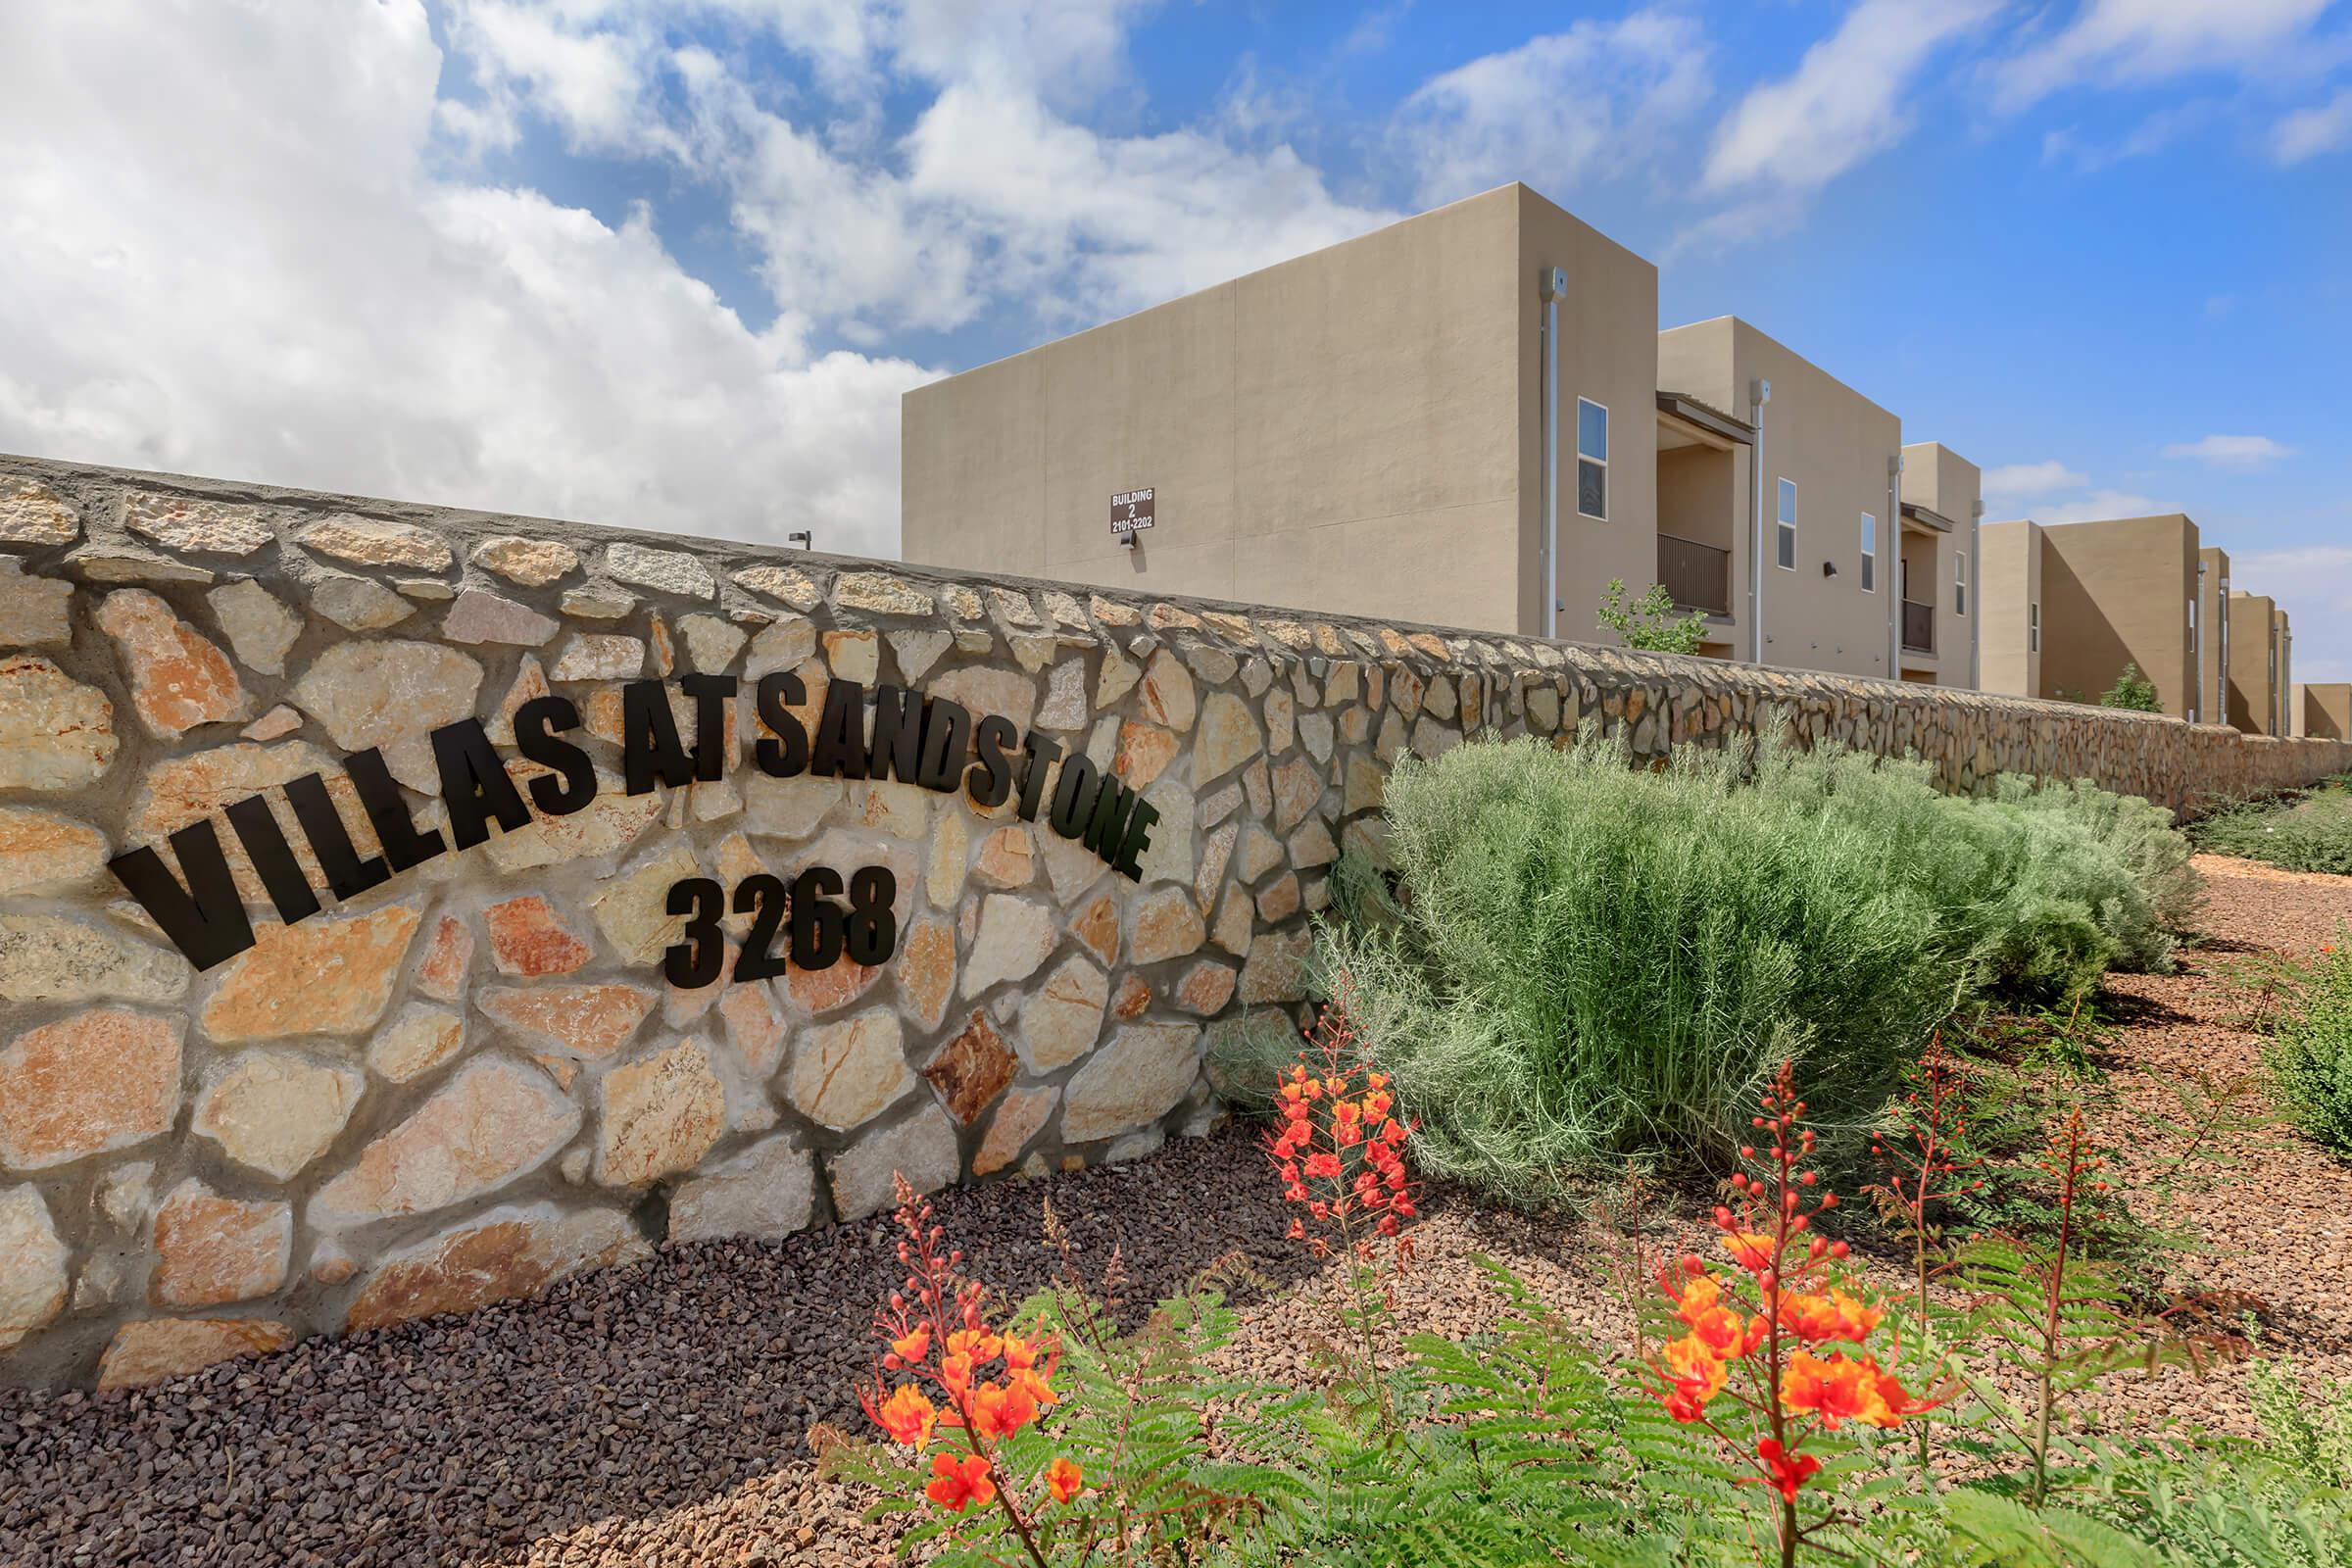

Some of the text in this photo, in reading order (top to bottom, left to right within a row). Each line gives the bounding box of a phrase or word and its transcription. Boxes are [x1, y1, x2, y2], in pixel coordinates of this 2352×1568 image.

[1112, 489, 1152, 507] BUILDING
[1128, 504, 1136, 518] 2
[1112, 515, 1152, 532] 2101-2202
[108, 671, 1160, 972] VILLAS AT SANDSTONE
[665, 865, 896, 989] 3268
